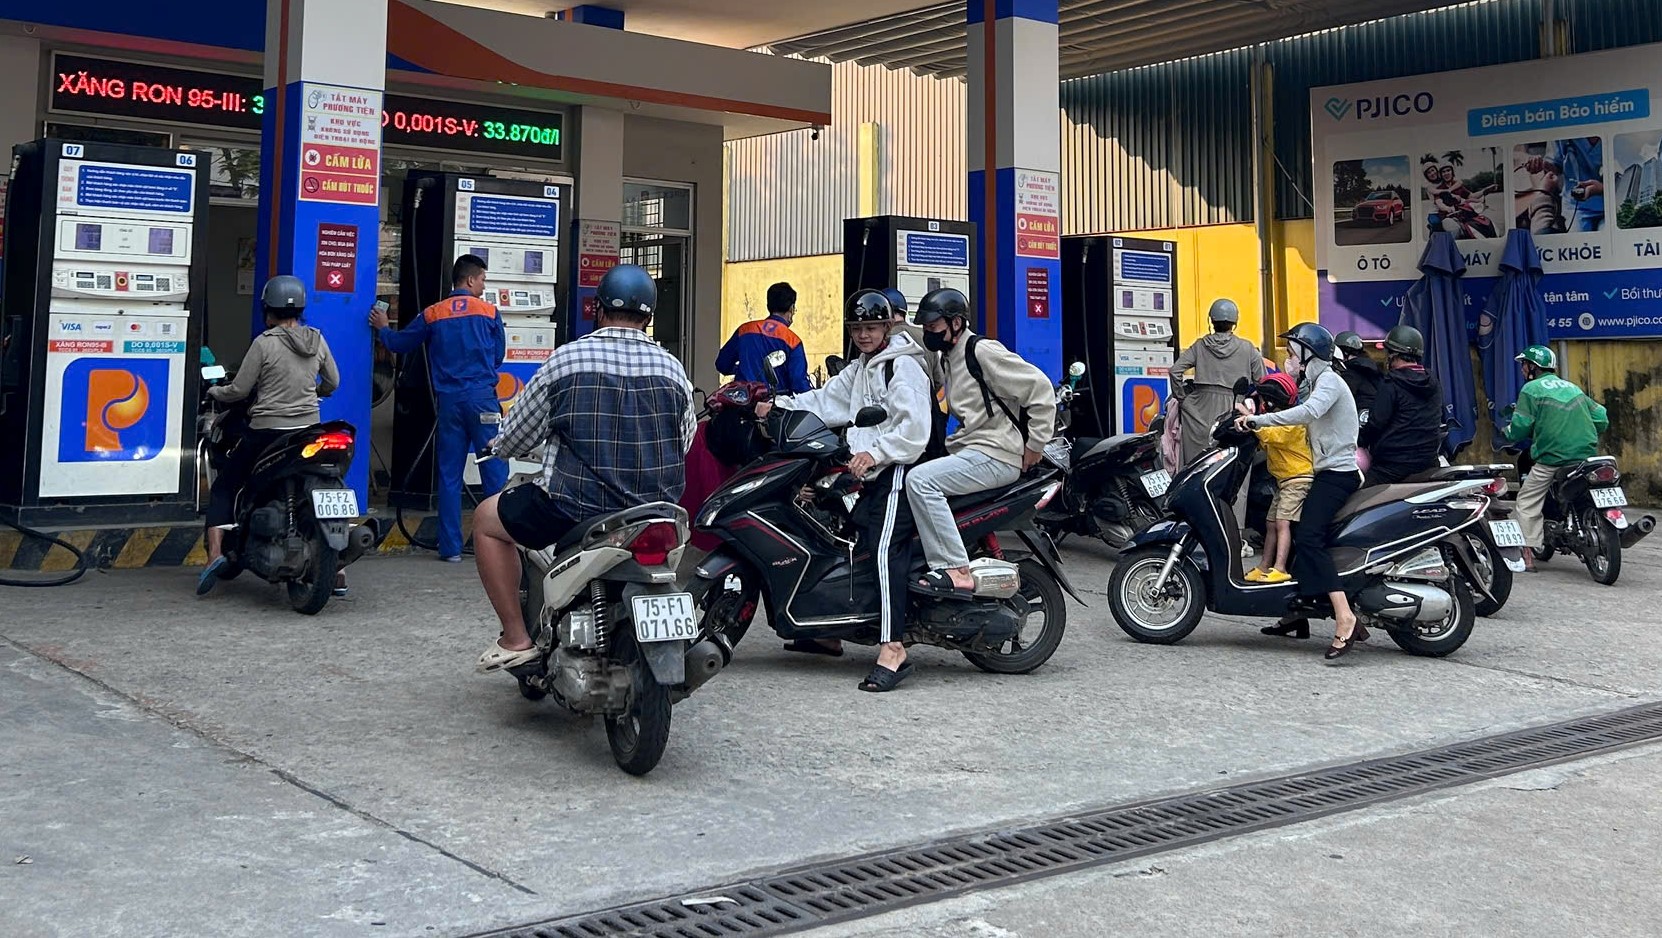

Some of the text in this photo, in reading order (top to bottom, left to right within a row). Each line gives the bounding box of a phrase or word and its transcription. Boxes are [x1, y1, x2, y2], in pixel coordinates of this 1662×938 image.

[57, 71, 125, 98] XĂNG
[132, 81, 182, 106] RON
[187, 88, 246, 113] 95-III:
[1356, 92, 1434, 120] PJICO
[1481, 97, 1635, 128] Điểm bán Bảo hiểm
[394, 111, 478, 137] 0,001S-V:
[66, 146, 80, 156] 07
[180, 156, 192, 165] 06
[326, 153, 372, 170] CẤM LỬA
[461, 180, 472, 189] 05
[547, 188, 557, 196] 04
[1558, 242, 1602, 261] KHỎE
[1634, 239, 1660, 257] TÀI
[1357, 253, 1391, 270] Ô TÔ
[1544, 291, 1589, 304] tận tâm
[62, 323, 82, 331] VISA
[1558, 318, 1572, 327] 55
[1494, 522, 1516, 532] 75-F1
[642, 597, 684, 618] 75-F1
[640, 617, 694, 639] 071.66
